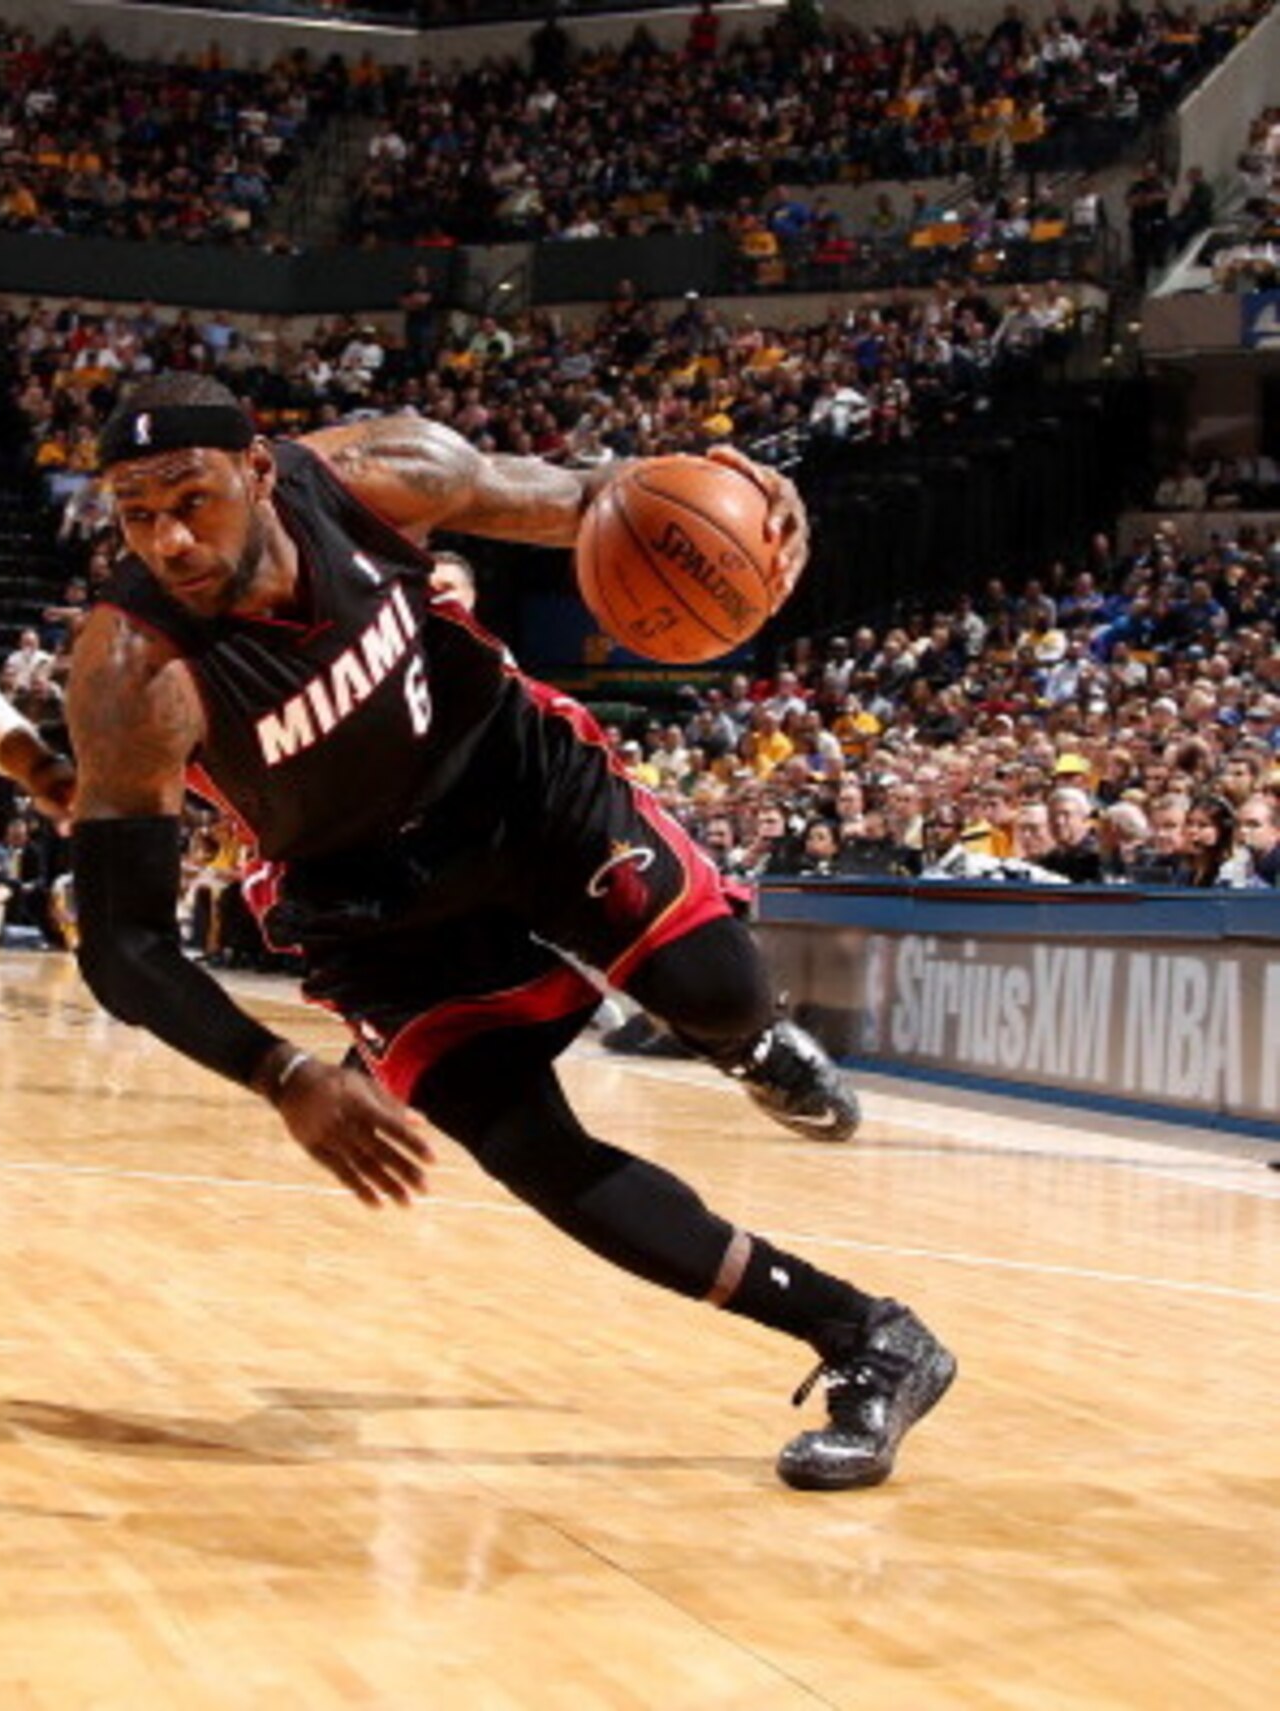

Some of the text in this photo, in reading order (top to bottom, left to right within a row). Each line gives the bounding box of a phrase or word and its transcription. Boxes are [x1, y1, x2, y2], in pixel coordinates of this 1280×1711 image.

[255, 581, 417, 766] MIAMI
[403, 654, 433, 738] 6
[892, 935, 1115, 1083] SiriusXM
[1122, 951, 1243, 1106] NBA
